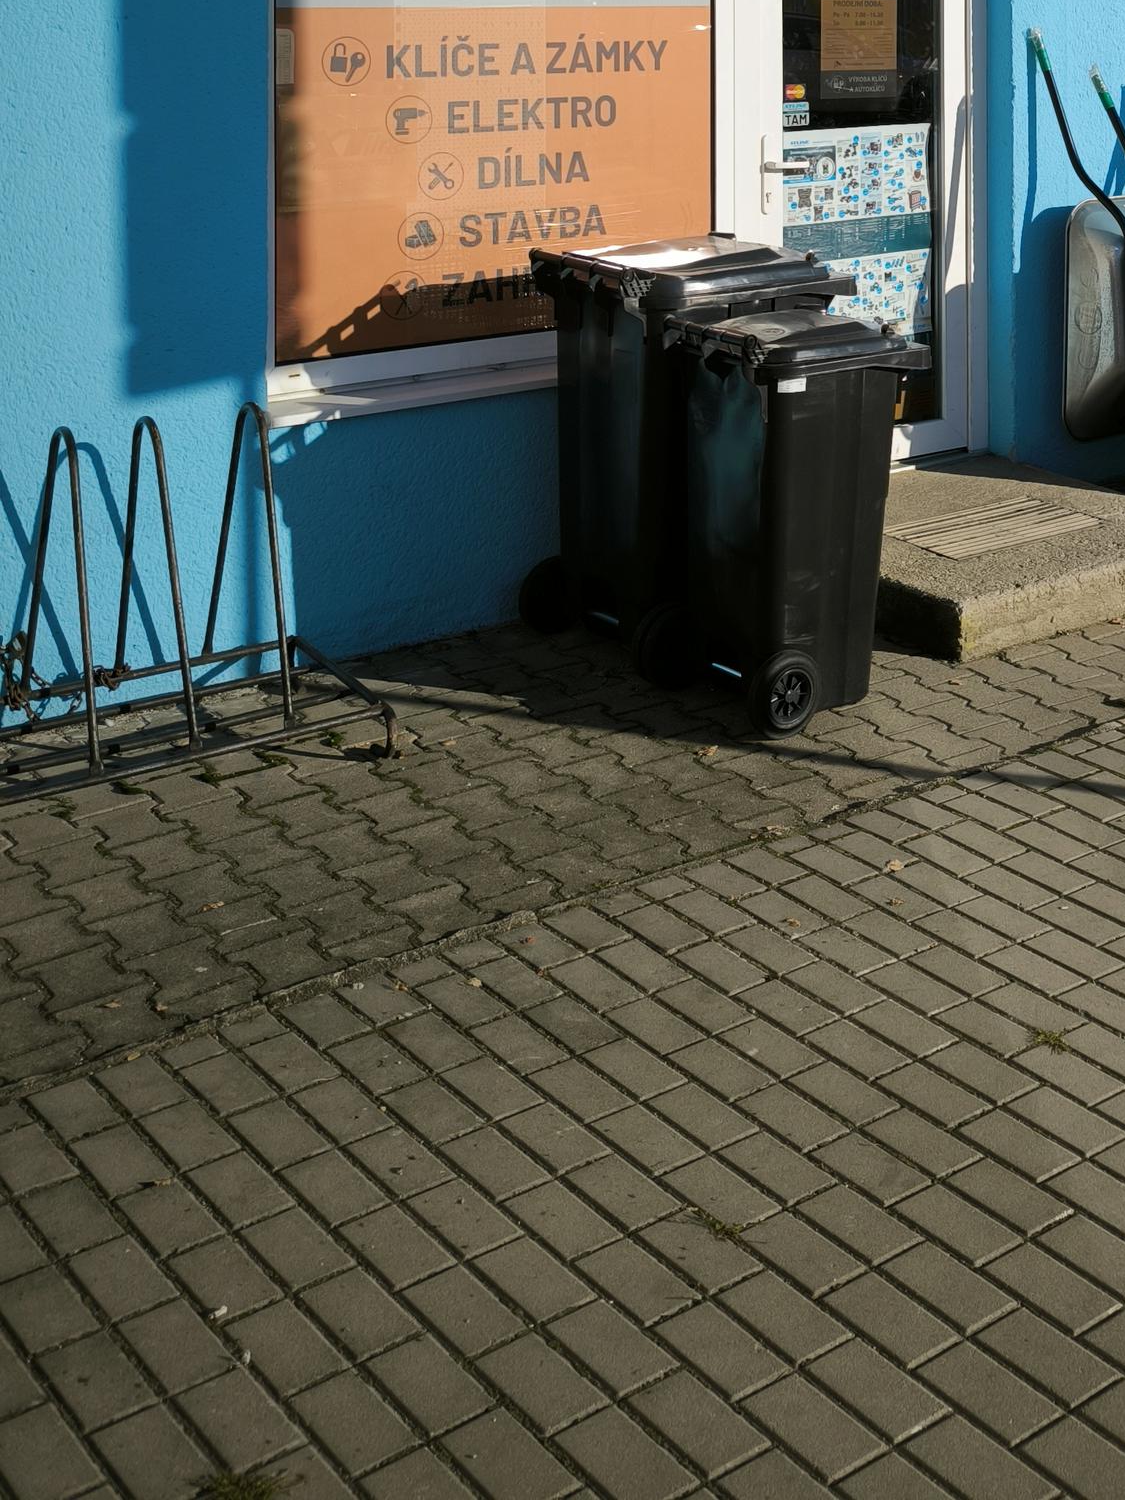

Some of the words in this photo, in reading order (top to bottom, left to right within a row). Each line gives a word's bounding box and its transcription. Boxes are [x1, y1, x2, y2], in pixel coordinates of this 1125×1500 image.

[385, 34, 500, 79] KLÍČE
[511, 42, 536, 75] A
[545, 34, 669, 75] ZÁMKY
[446, 94, 618, 134] ELEKTRO
[785, 114, 807, 125] TAM
[477, 147, 591, 189] DÍLNA
[459, 203, 608, 248] STAVBA
[441, 265, 531, 308] ZAH
